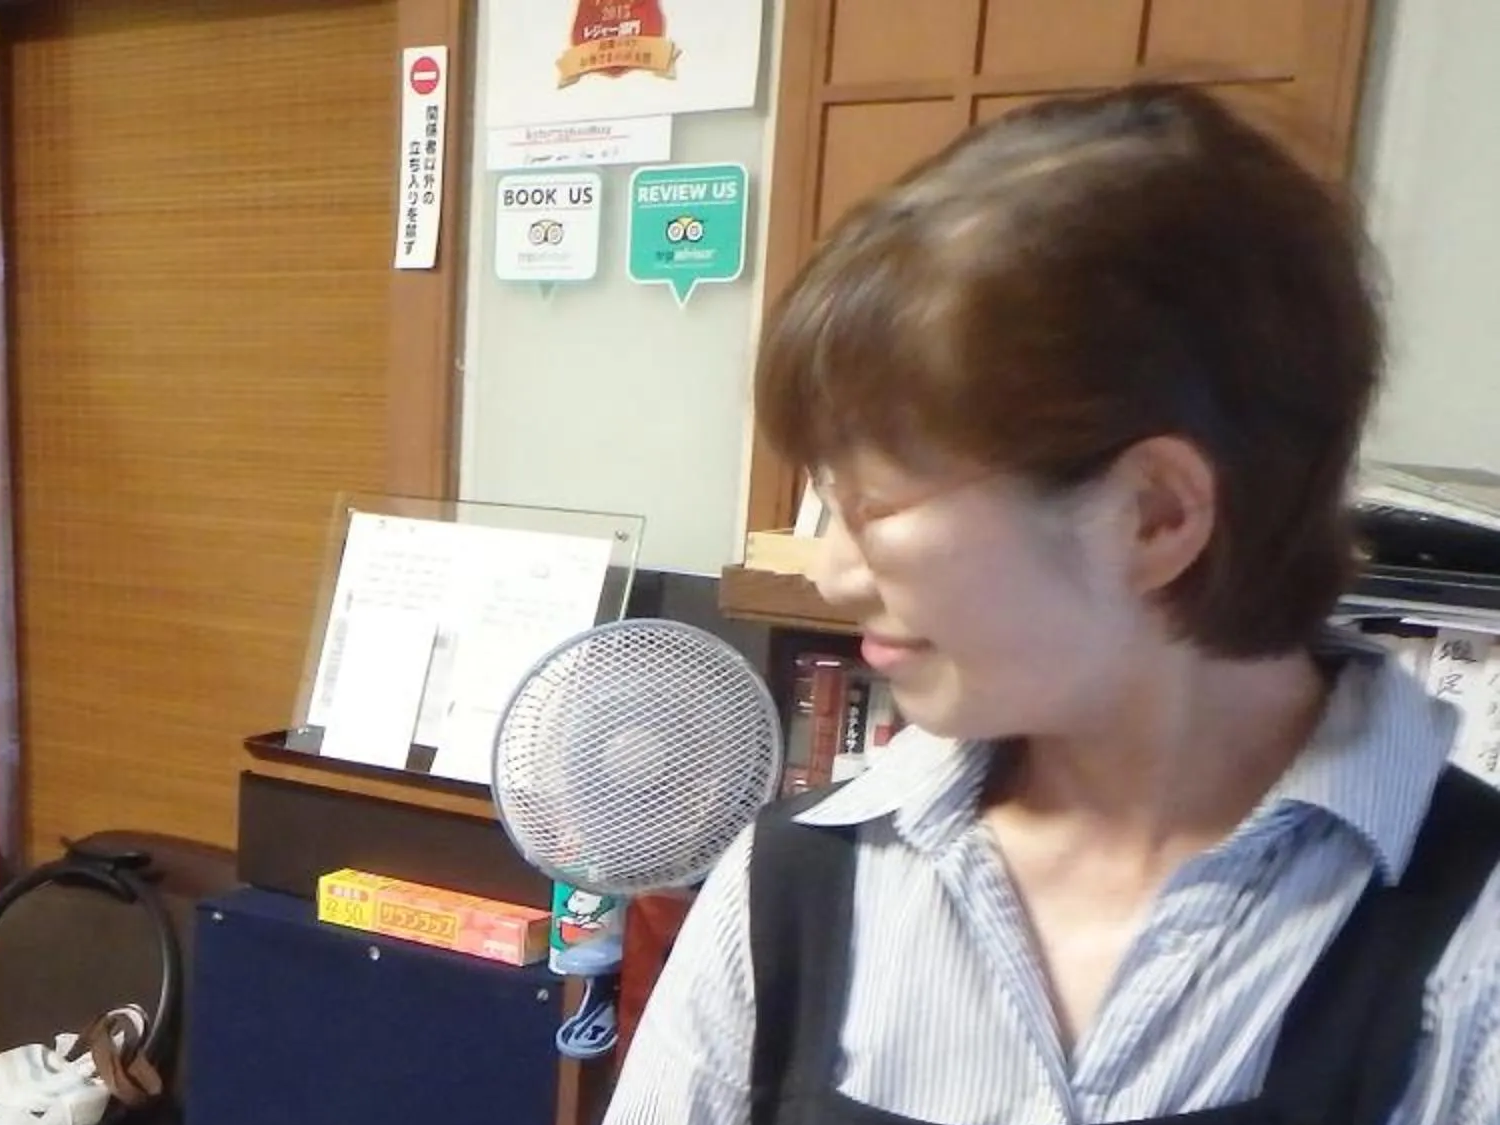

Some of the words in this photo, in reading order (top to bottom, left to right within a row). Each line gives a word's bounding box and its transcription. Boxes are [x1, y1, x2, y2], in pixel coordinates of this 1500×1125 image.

[503, 188, 558, 206] BOOK
[568, 186, 594, 205] US
[637, 182, 708, 203] REVIEW
[712, 181, 739, 199] US
